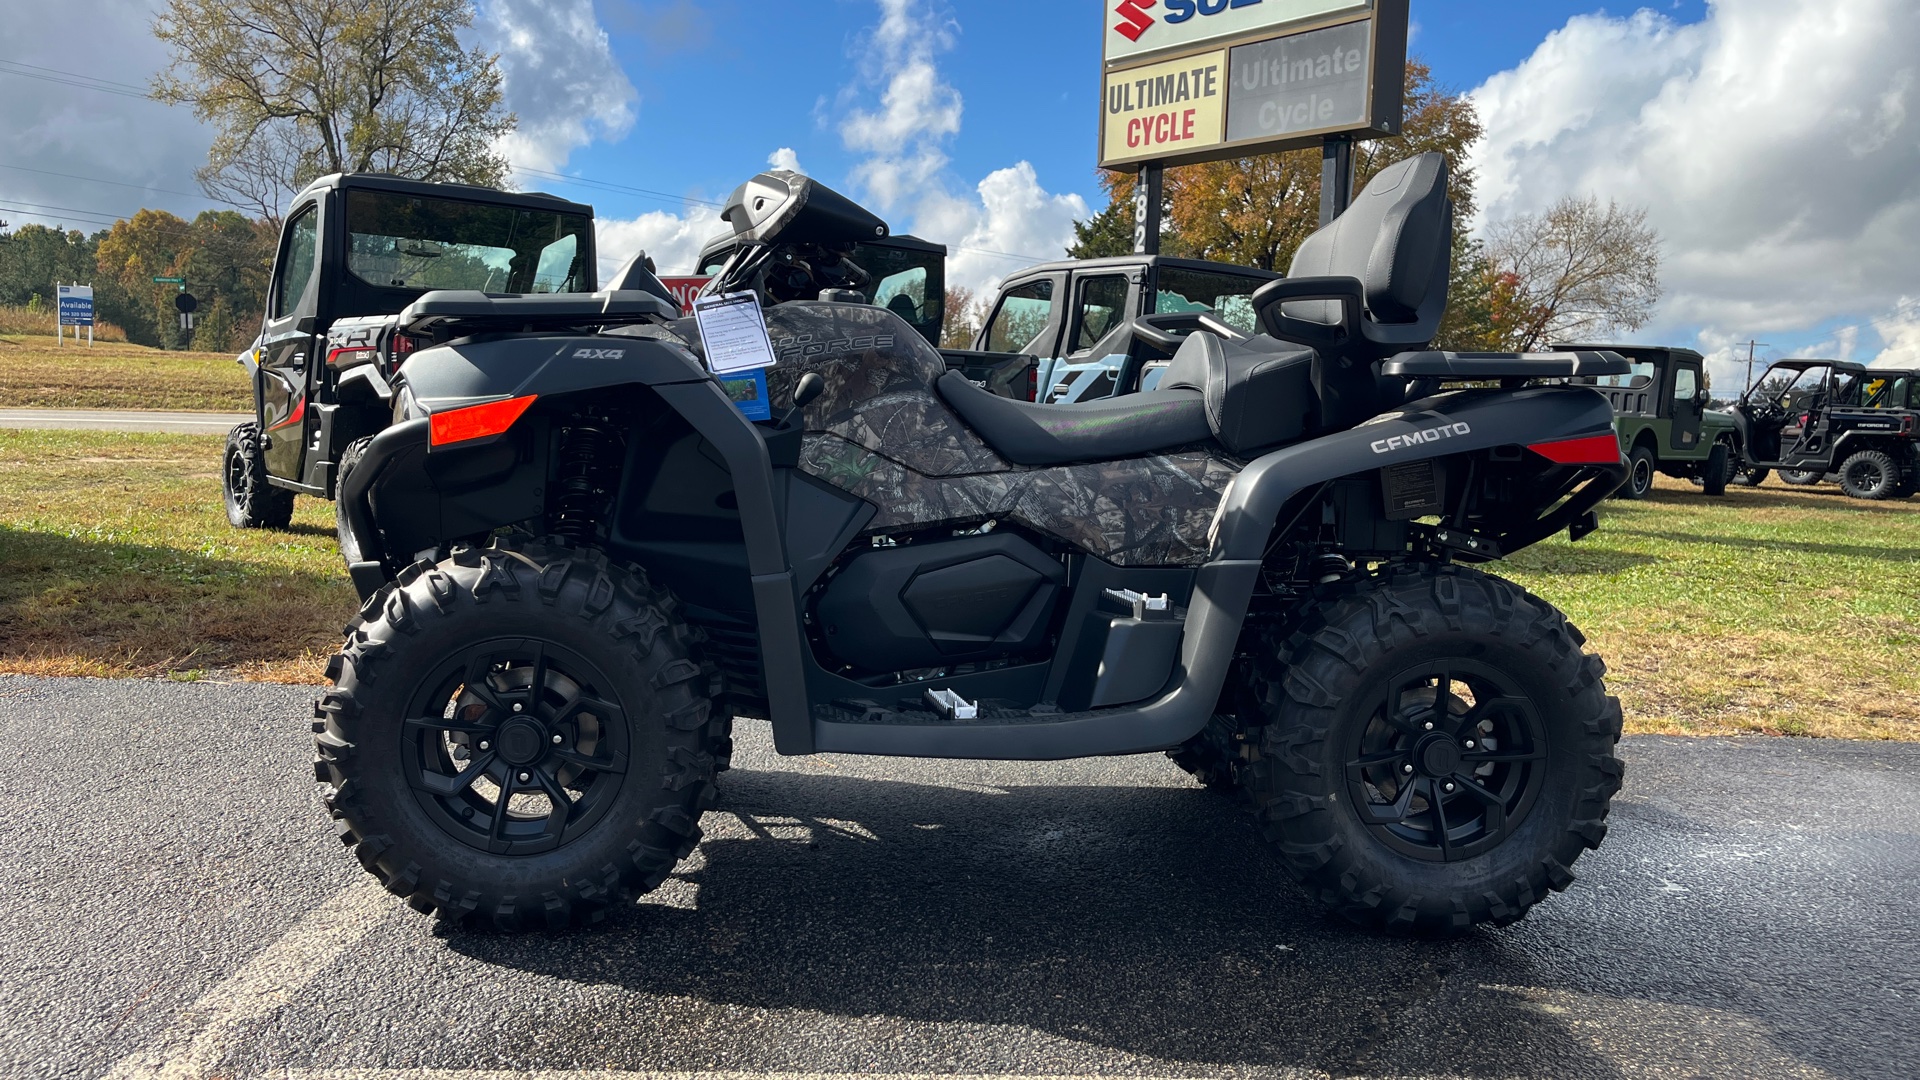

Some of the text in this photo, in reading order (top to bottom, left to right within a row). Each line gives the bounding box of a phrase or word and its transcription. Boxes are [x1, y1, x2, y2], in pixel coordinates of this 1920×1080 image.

[1241, 46, 1361, 91] Ultimate
[1109, 65, 1217, 114] ULTIMATE
[1127, 109, 1196, 148] CYCLE
[1258, 94, 1334, 132] Cycle
[60, 301, 92, 309] Available
[1370, 421, 1470, 454] CFMOTO
